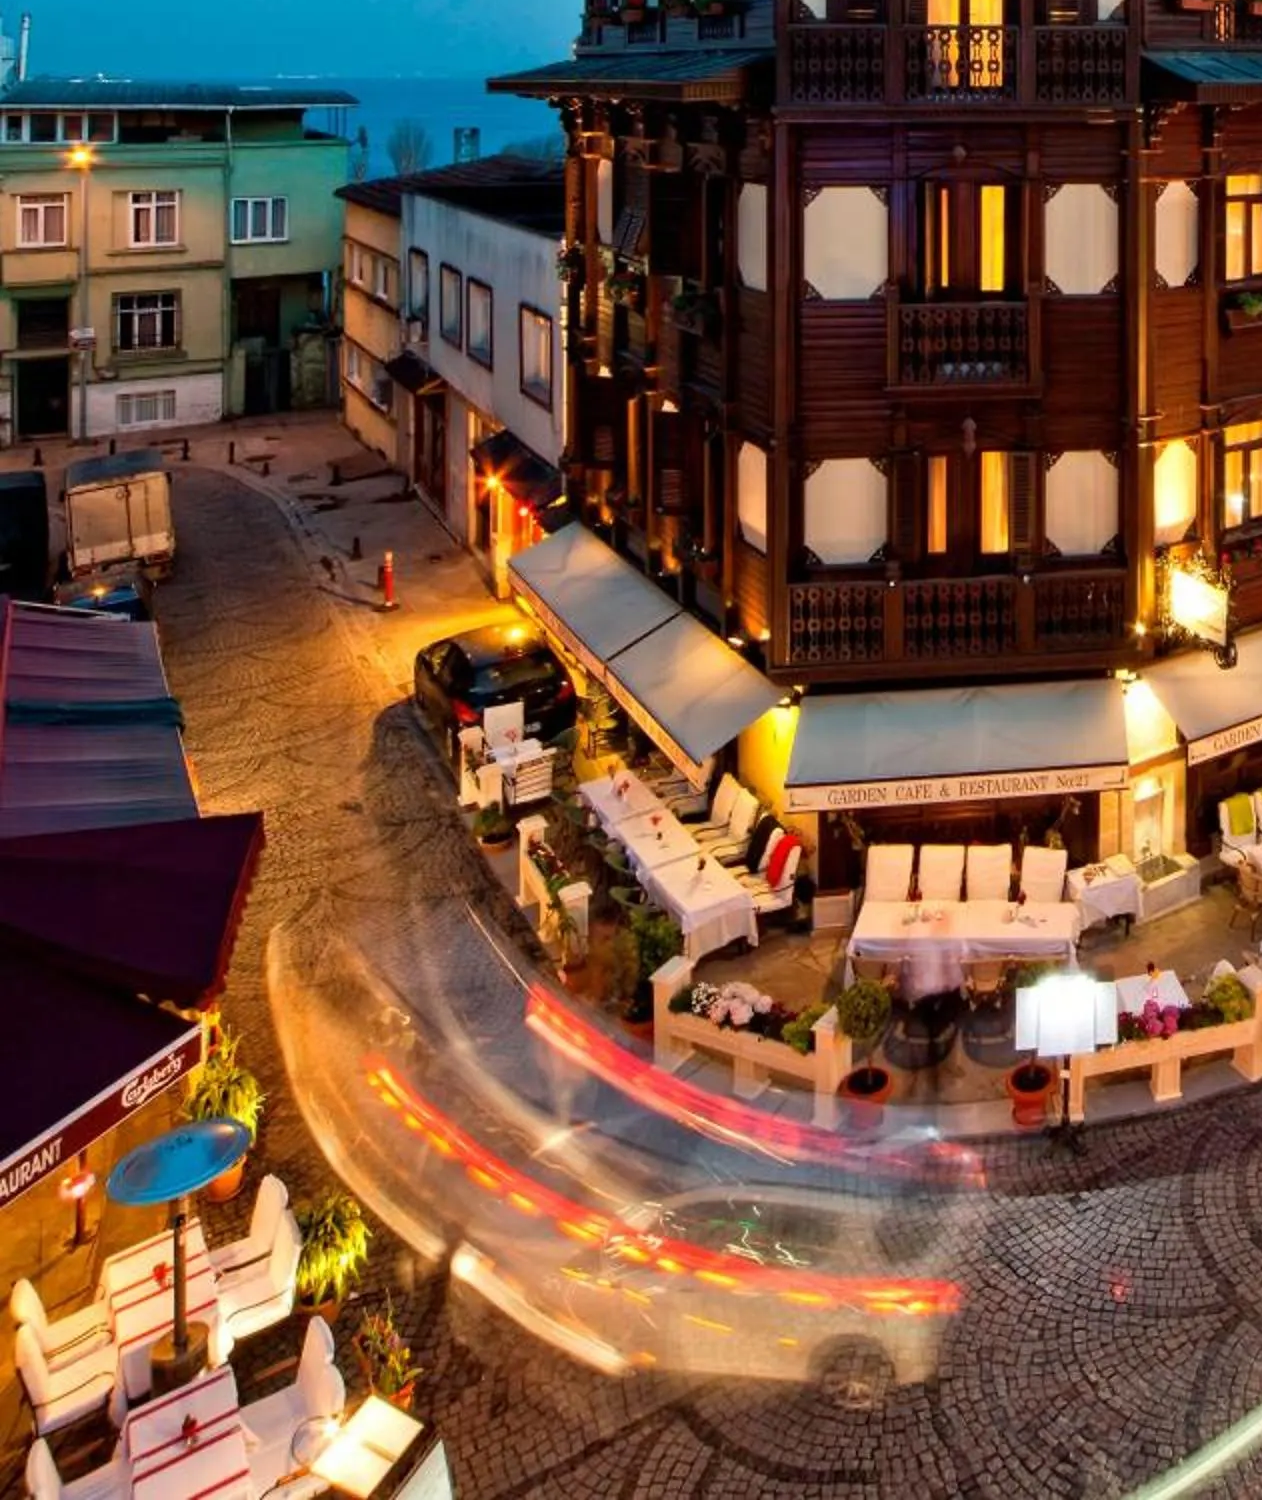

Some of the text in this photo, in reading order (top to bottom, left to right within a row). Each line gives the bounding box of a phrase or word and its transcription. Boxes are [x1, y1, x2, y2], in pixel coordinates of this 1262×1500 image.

[1213, 722, 1262, 750] GARDEN
[827, 786, 888, 805] GARDEN
[895, 783, 933, 801] CAFE
[939, 784, 951, 798] &
[958, 775, 1049, 797] RESTAURANT
[121, 1052, 186, 1108] Carlsberg
